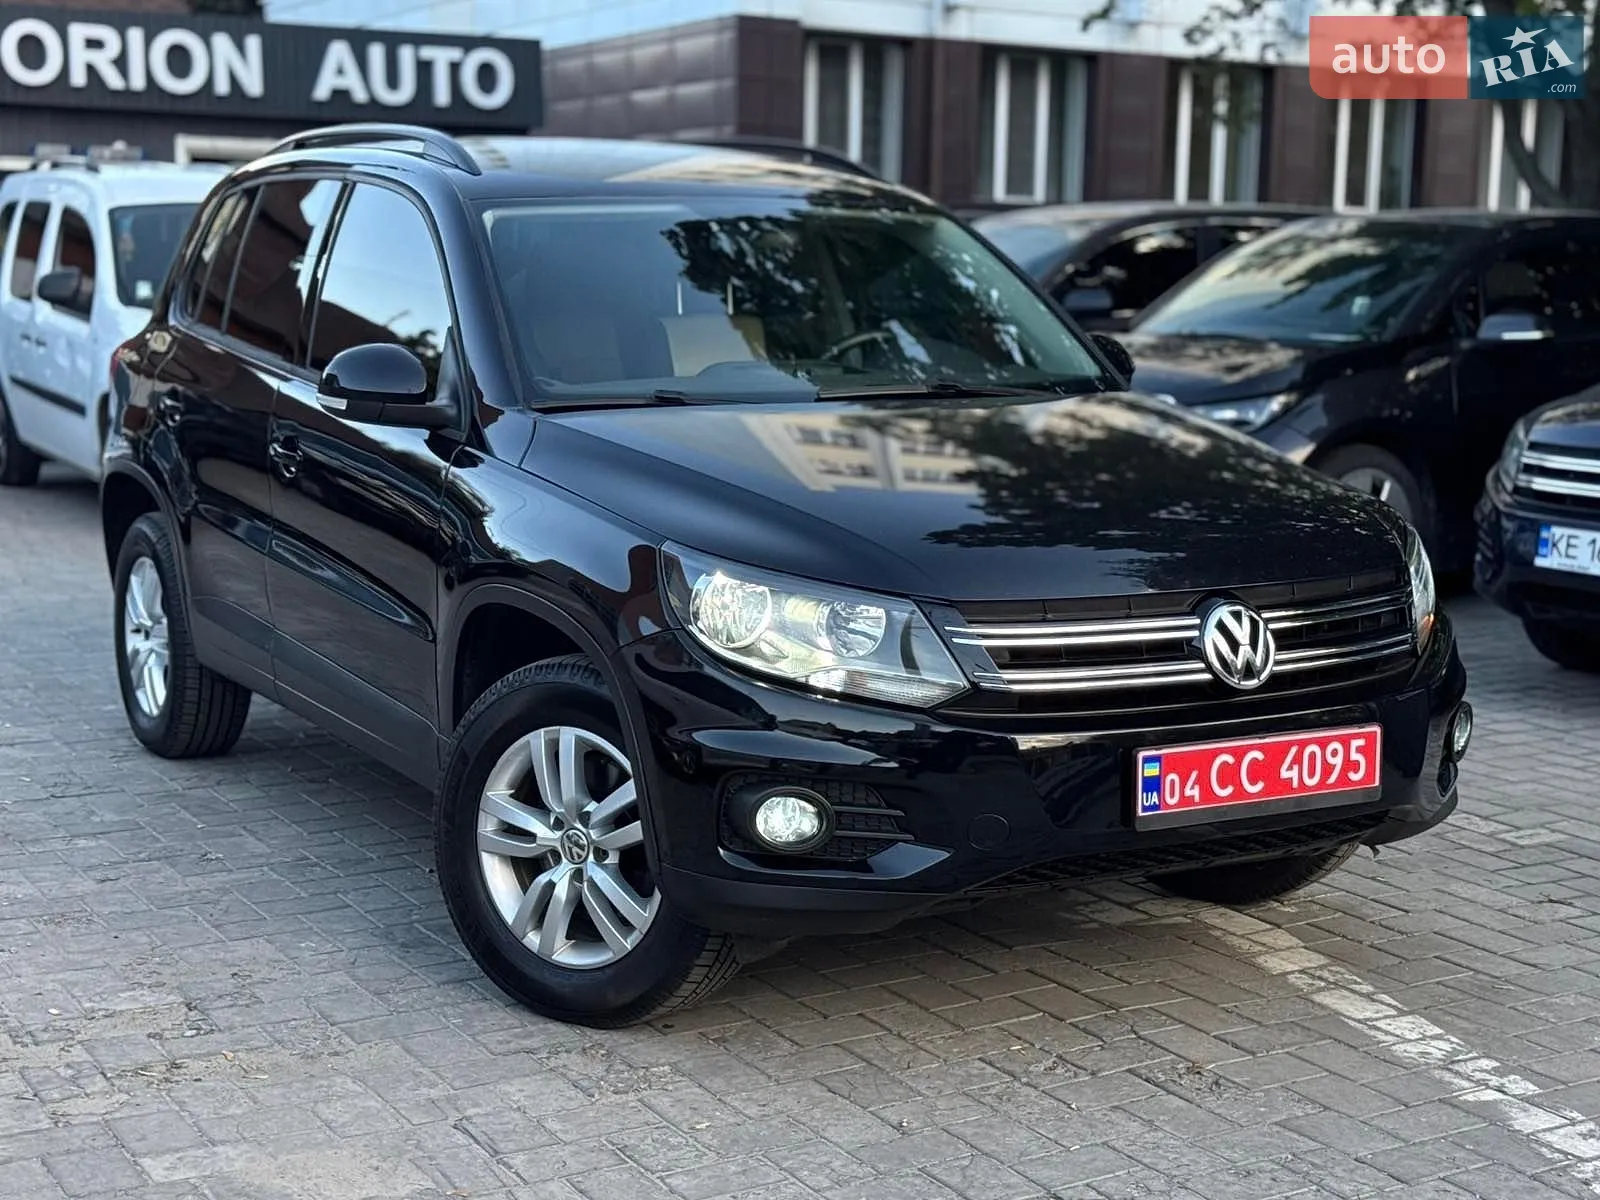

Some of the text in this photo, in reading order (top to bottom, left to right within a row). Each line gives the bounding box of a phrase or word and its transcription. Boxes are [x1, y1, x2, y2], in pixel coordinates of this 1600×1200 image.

[0, 17, 515, 110] ORION AUTO
[1550, 533, 1580, 560] KE
[1164, 738, 1366, 806] 04 CC 4095
[1143, 791, 1159, 807] UA
